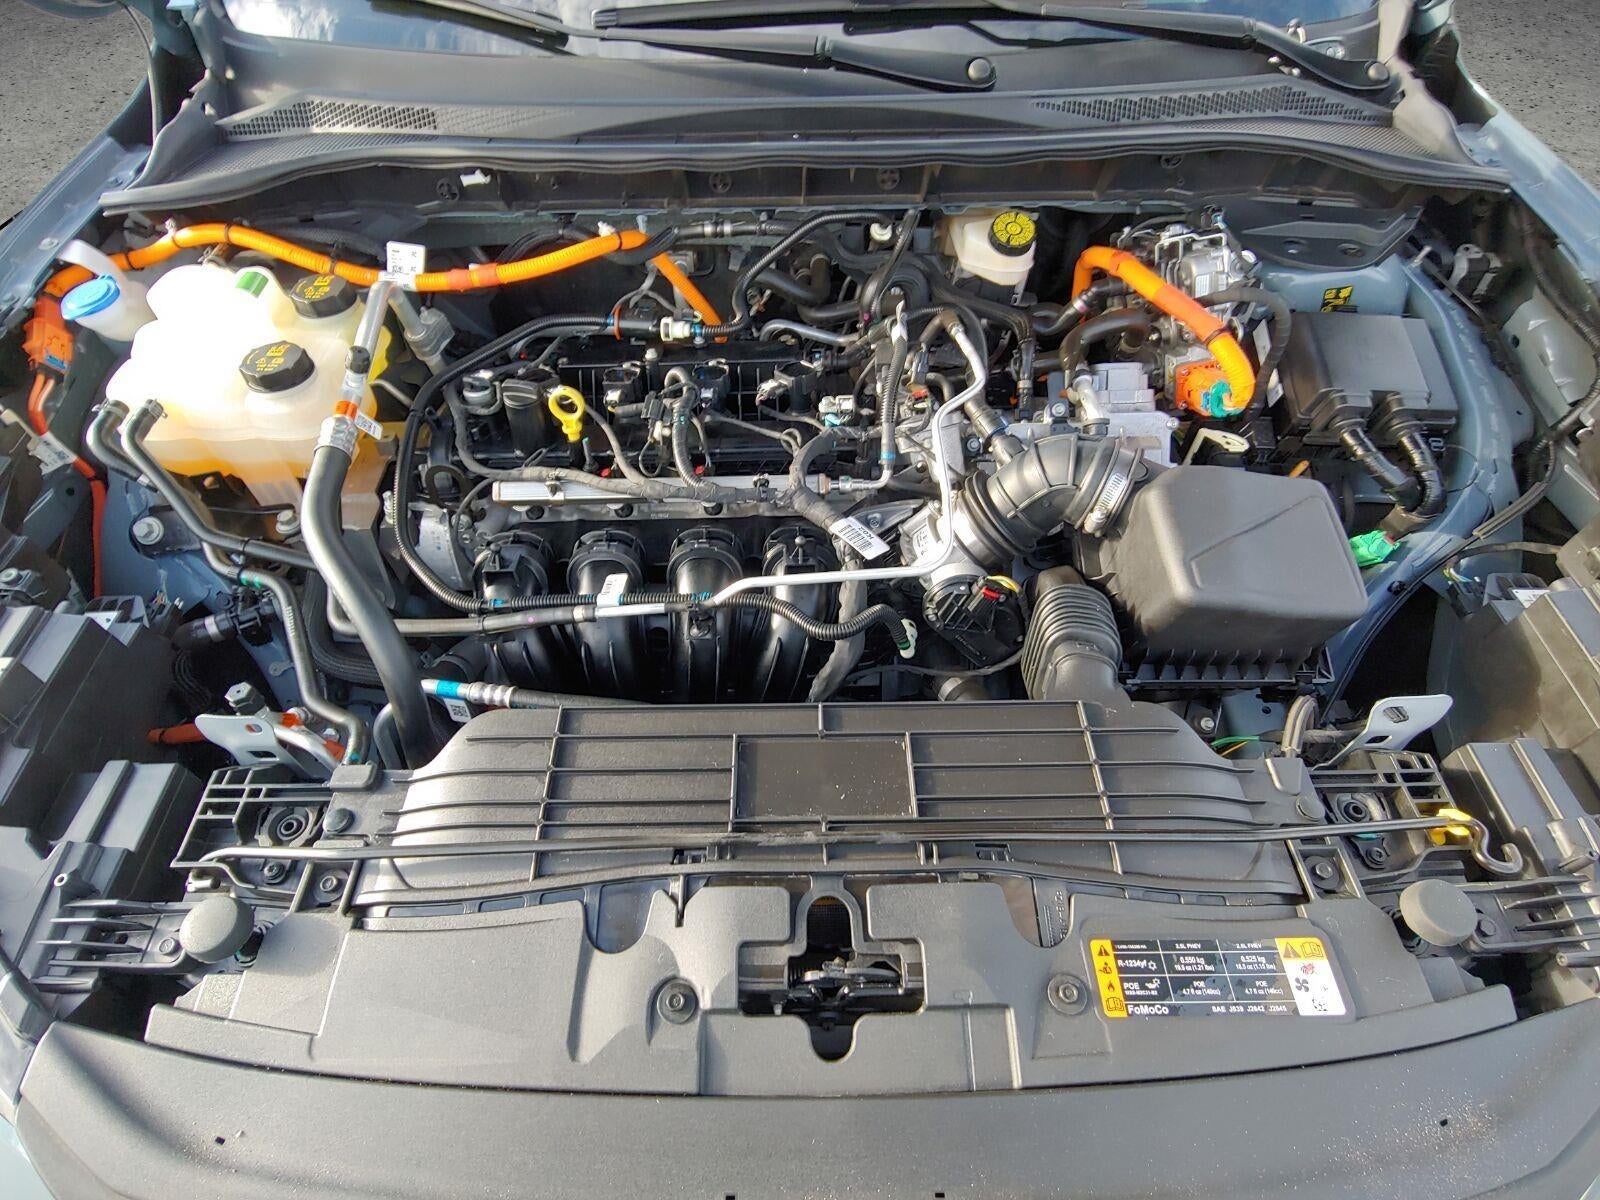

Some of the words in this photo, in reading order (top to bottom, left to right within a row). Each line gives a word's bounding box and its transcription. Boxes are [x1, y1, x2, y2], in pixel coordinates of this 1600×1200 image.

[1117, 959, 1147, 969] R-1234yf
[1196, 956, 1205, 965] kg
[1257, 955, 1266, 964] kg
[1123, 982, 1140, 990] POE
[1193, 980, 1206, 988] POE
[1255, 980, 1268, 988] POE
[1127, 1004, 1169, 1014] FoMoCo
